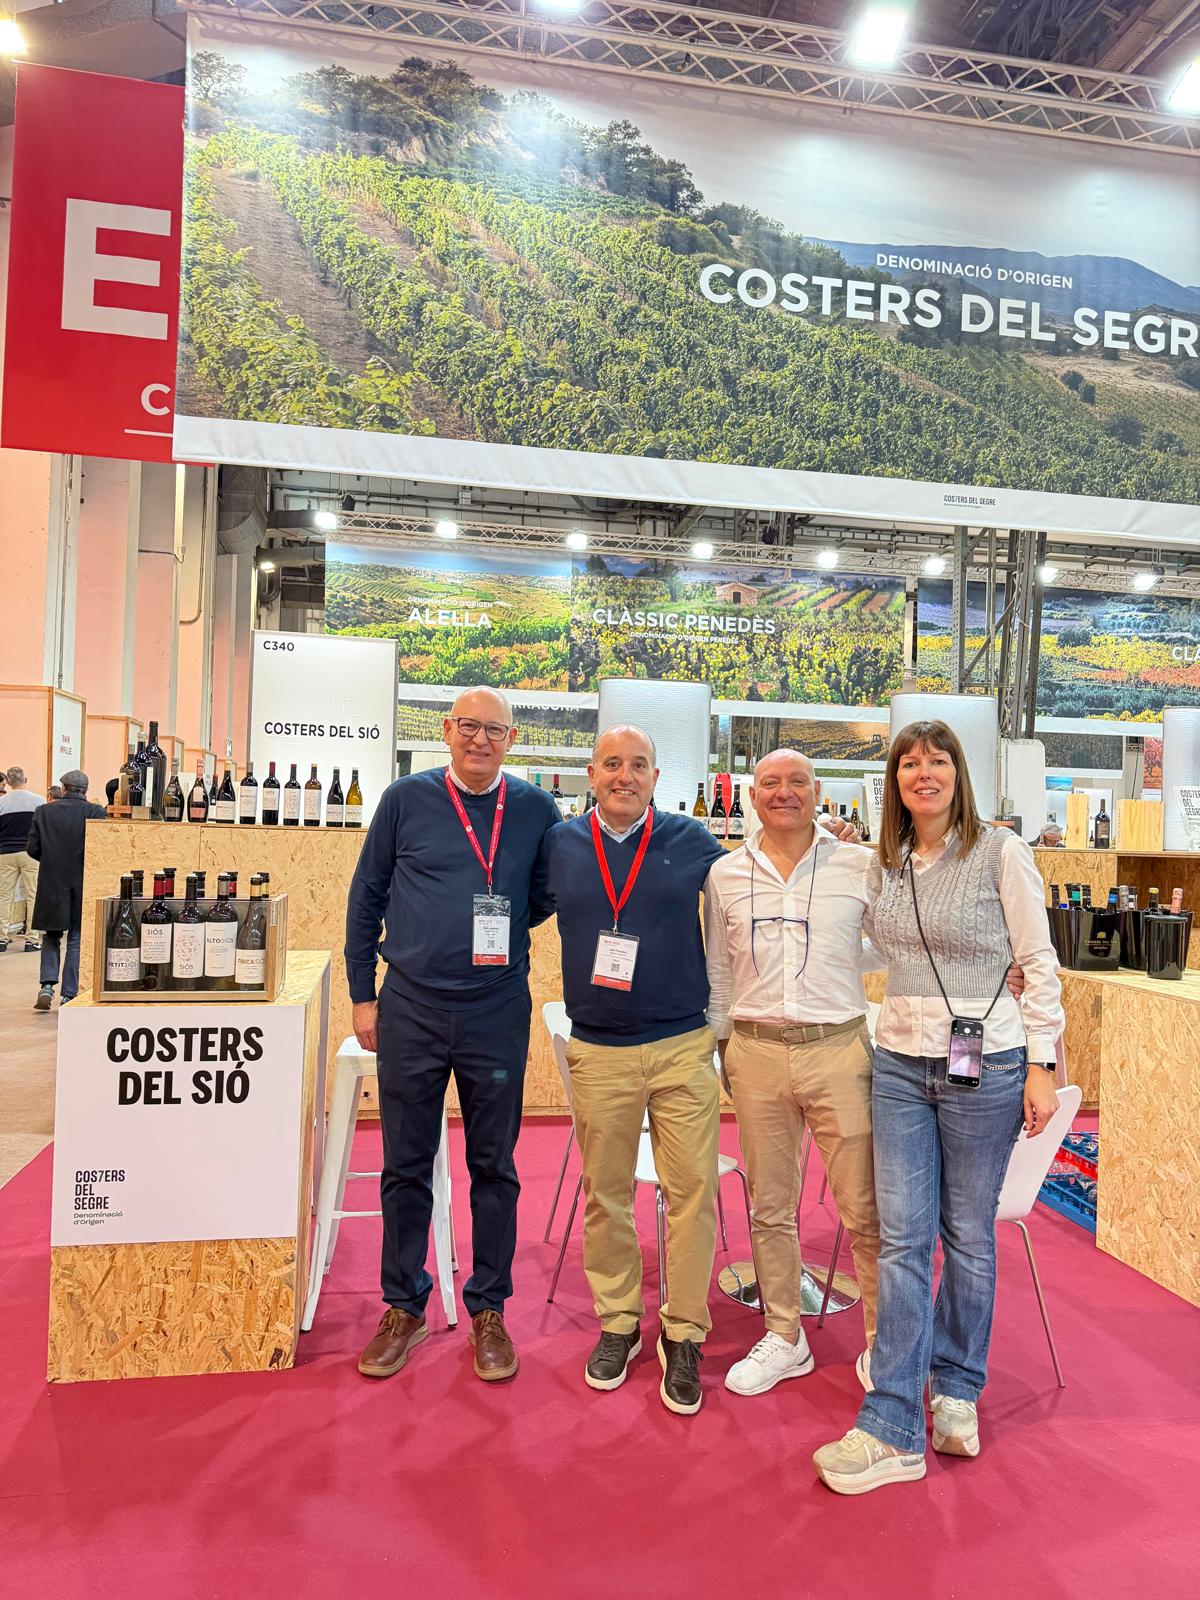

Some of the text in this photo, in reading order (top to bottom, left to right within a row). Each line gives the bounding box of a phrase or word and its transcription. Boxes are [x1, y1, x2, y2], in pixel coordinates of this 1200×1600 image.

[61, 198, 172, 341] E
[876, 253, 1074, 290] DENOMINACIÓ D'ORIGEN
[699, 262, 943, 329] COSTERS
[960, 293, 1057, 343] DEL
[968, 496, 979, 505] DEL
[979, 497, 997, 506] SEGRE
[407, 596, 458, 606] DENOMINACIÓ
[407, 606, 493, 629] ALELLA
[592, 606, 777, 635] CLÀSSIC PENEDÈS
[263, 639, 295, 652] C340
[264, 721, 380, 741] COSTERS DEL SIÓ
[147, 928, 163, 936] SIÓS
[179, 962, 194, 971] SIÓS
[106, 1026, 264, 1063] COSTERS
[118, 1061, 250, 1105] DEL SIÓ
[74, 1183, 95, 1196] DEL
[74, 1196, 110, 1210] SEGRE
[73, 1211, 124, 1219] Denominació
[73, 1218, 105, 1226] d'Origen
